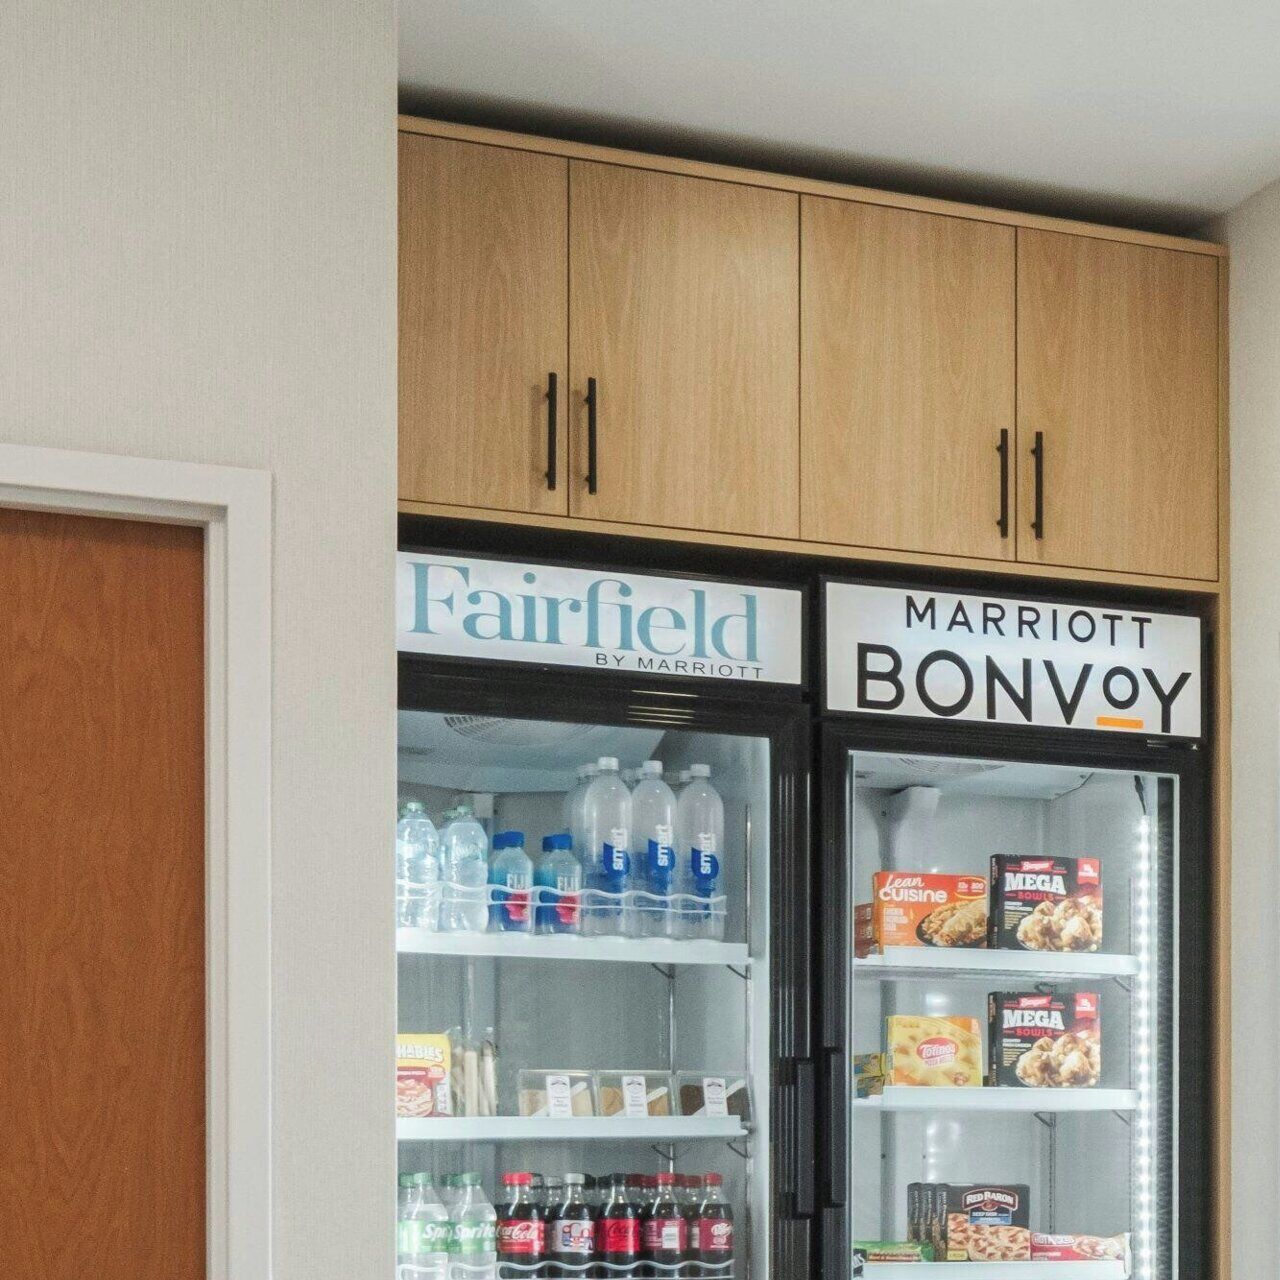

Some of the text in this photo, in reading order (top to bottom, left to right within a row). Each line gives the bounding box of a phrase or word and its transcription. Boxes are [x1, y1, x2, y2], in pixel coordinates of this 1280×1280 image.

[406, 561, 762, 662] Fairfield
[905, 595, 1152, 648] MARRIOTT
[595, 653, 765, 680] BY MARRIOTT
[856, 642, 1192, 734] BONVOY
[883, 874, 925, 891] Lean
[1004, 873, 1067, 895] MEGA
[1003, 1010, 1065, 1031] MEGA
[966, 1191, 1013, 1204] RED BARON
